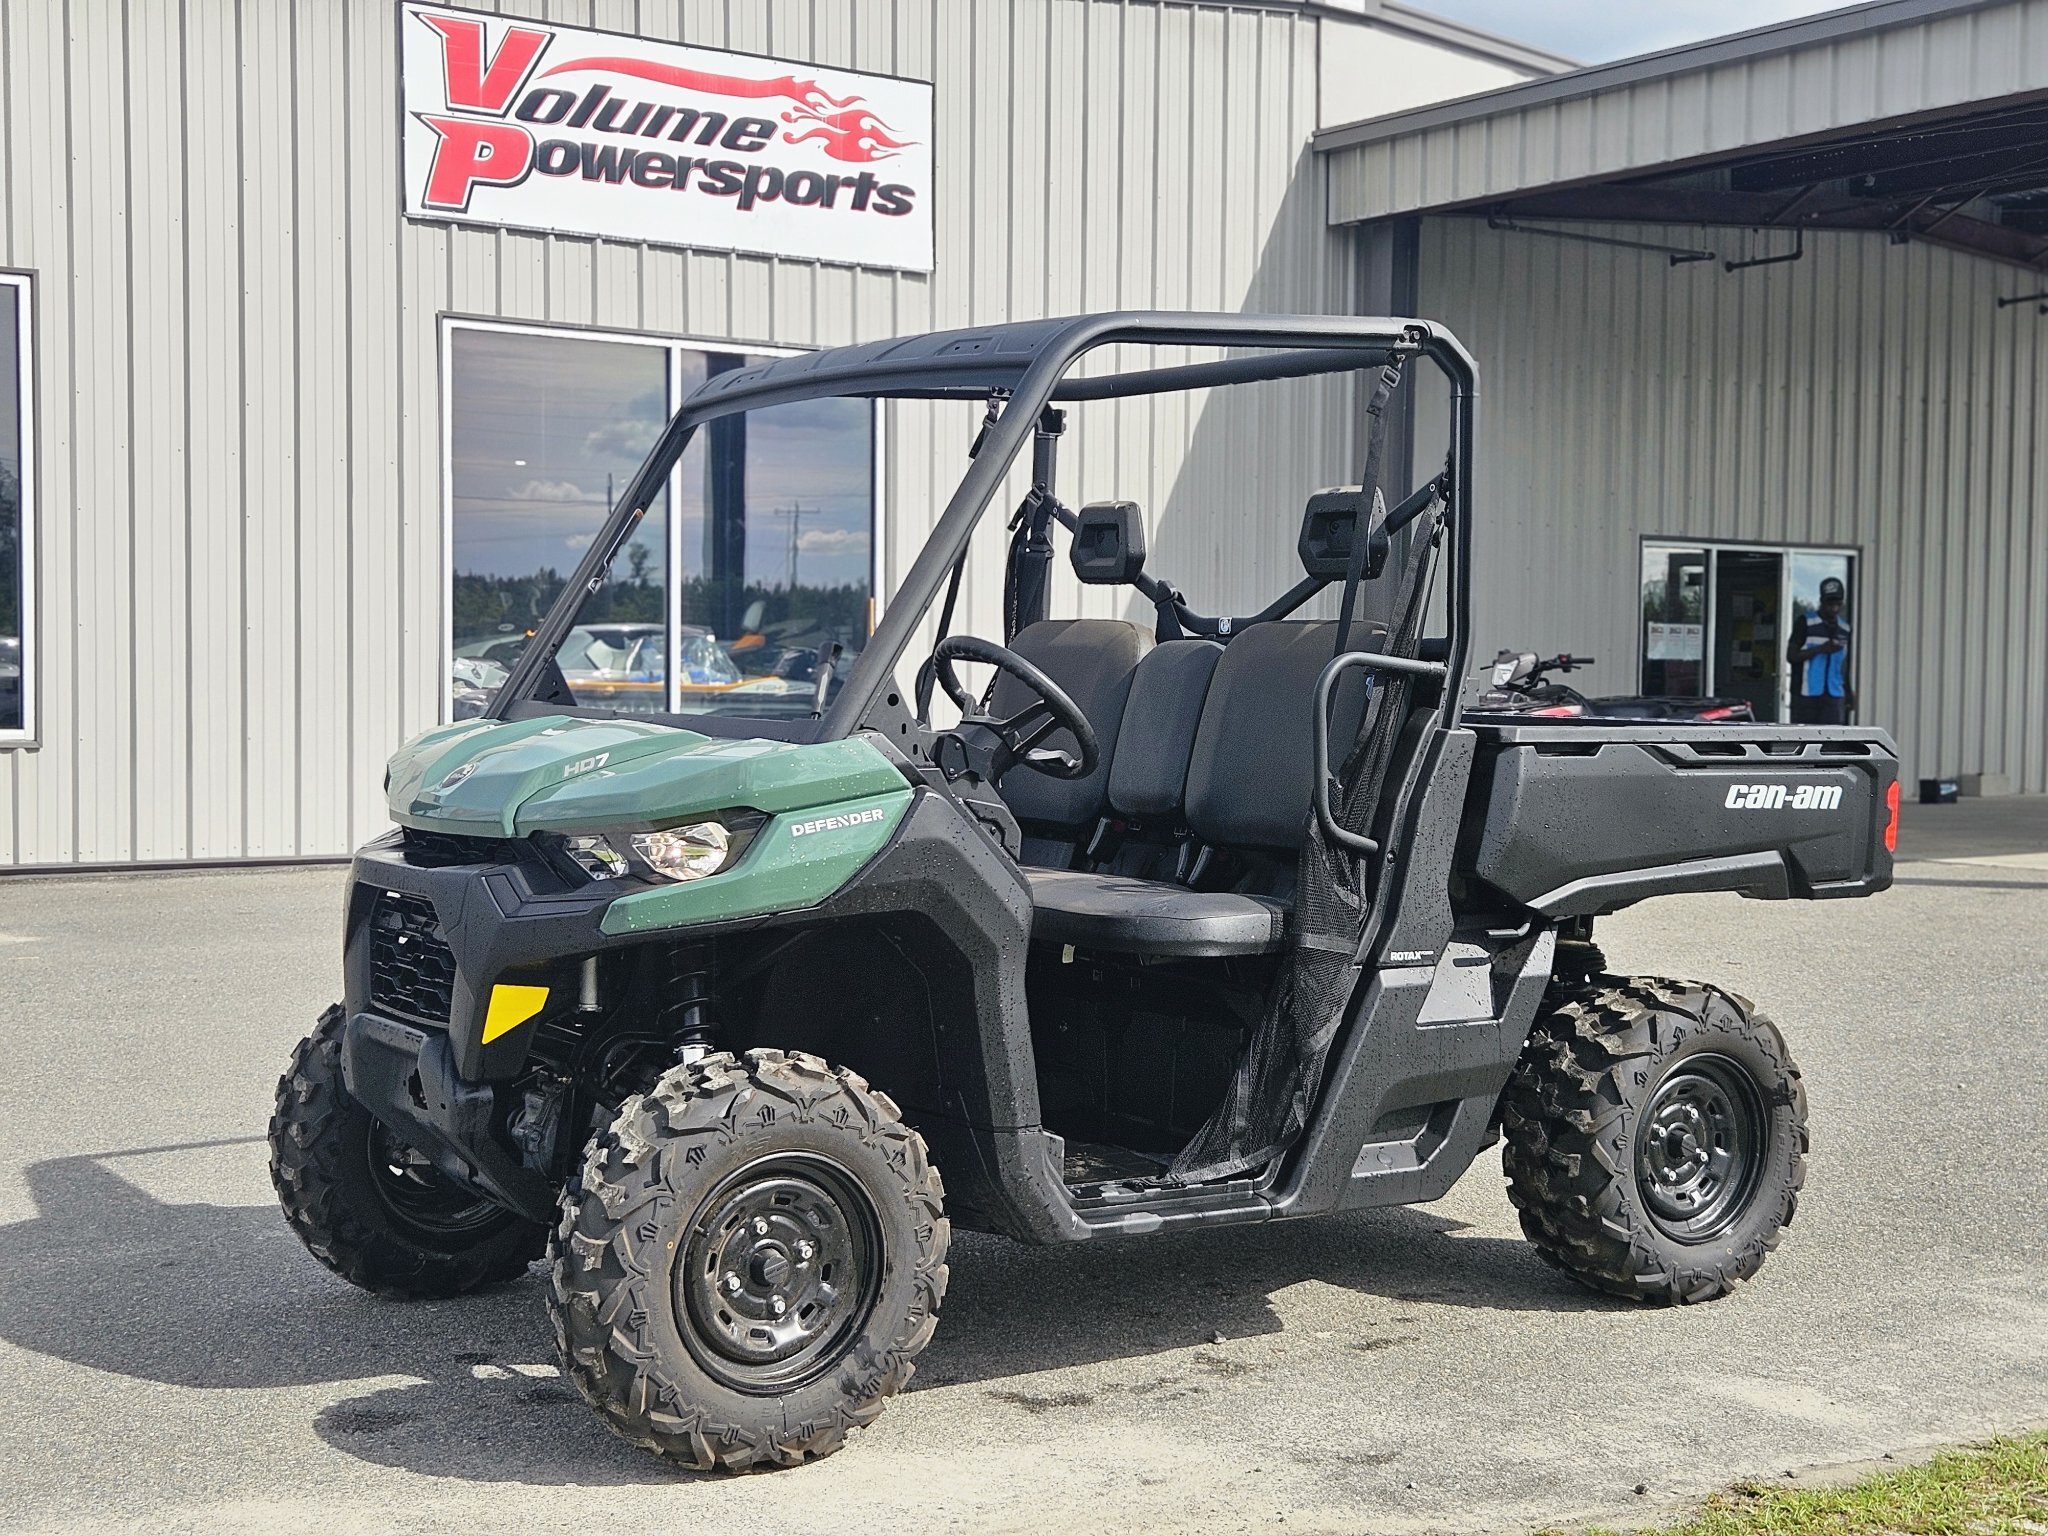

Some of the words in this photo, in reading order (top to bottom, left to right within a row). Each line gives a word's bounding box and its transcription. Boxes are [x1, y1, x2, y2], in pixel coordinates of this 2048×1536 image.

[408, 10, 778, 152] Volume
[408, 111, 917, 217] Powersports
[563, 752, 610, 778] HD7
[1724, 784, 1843, 810] can-am
[790, 808, 884, 837] DEFENDER
[1390, 950, 1422, 961] ROTAX
